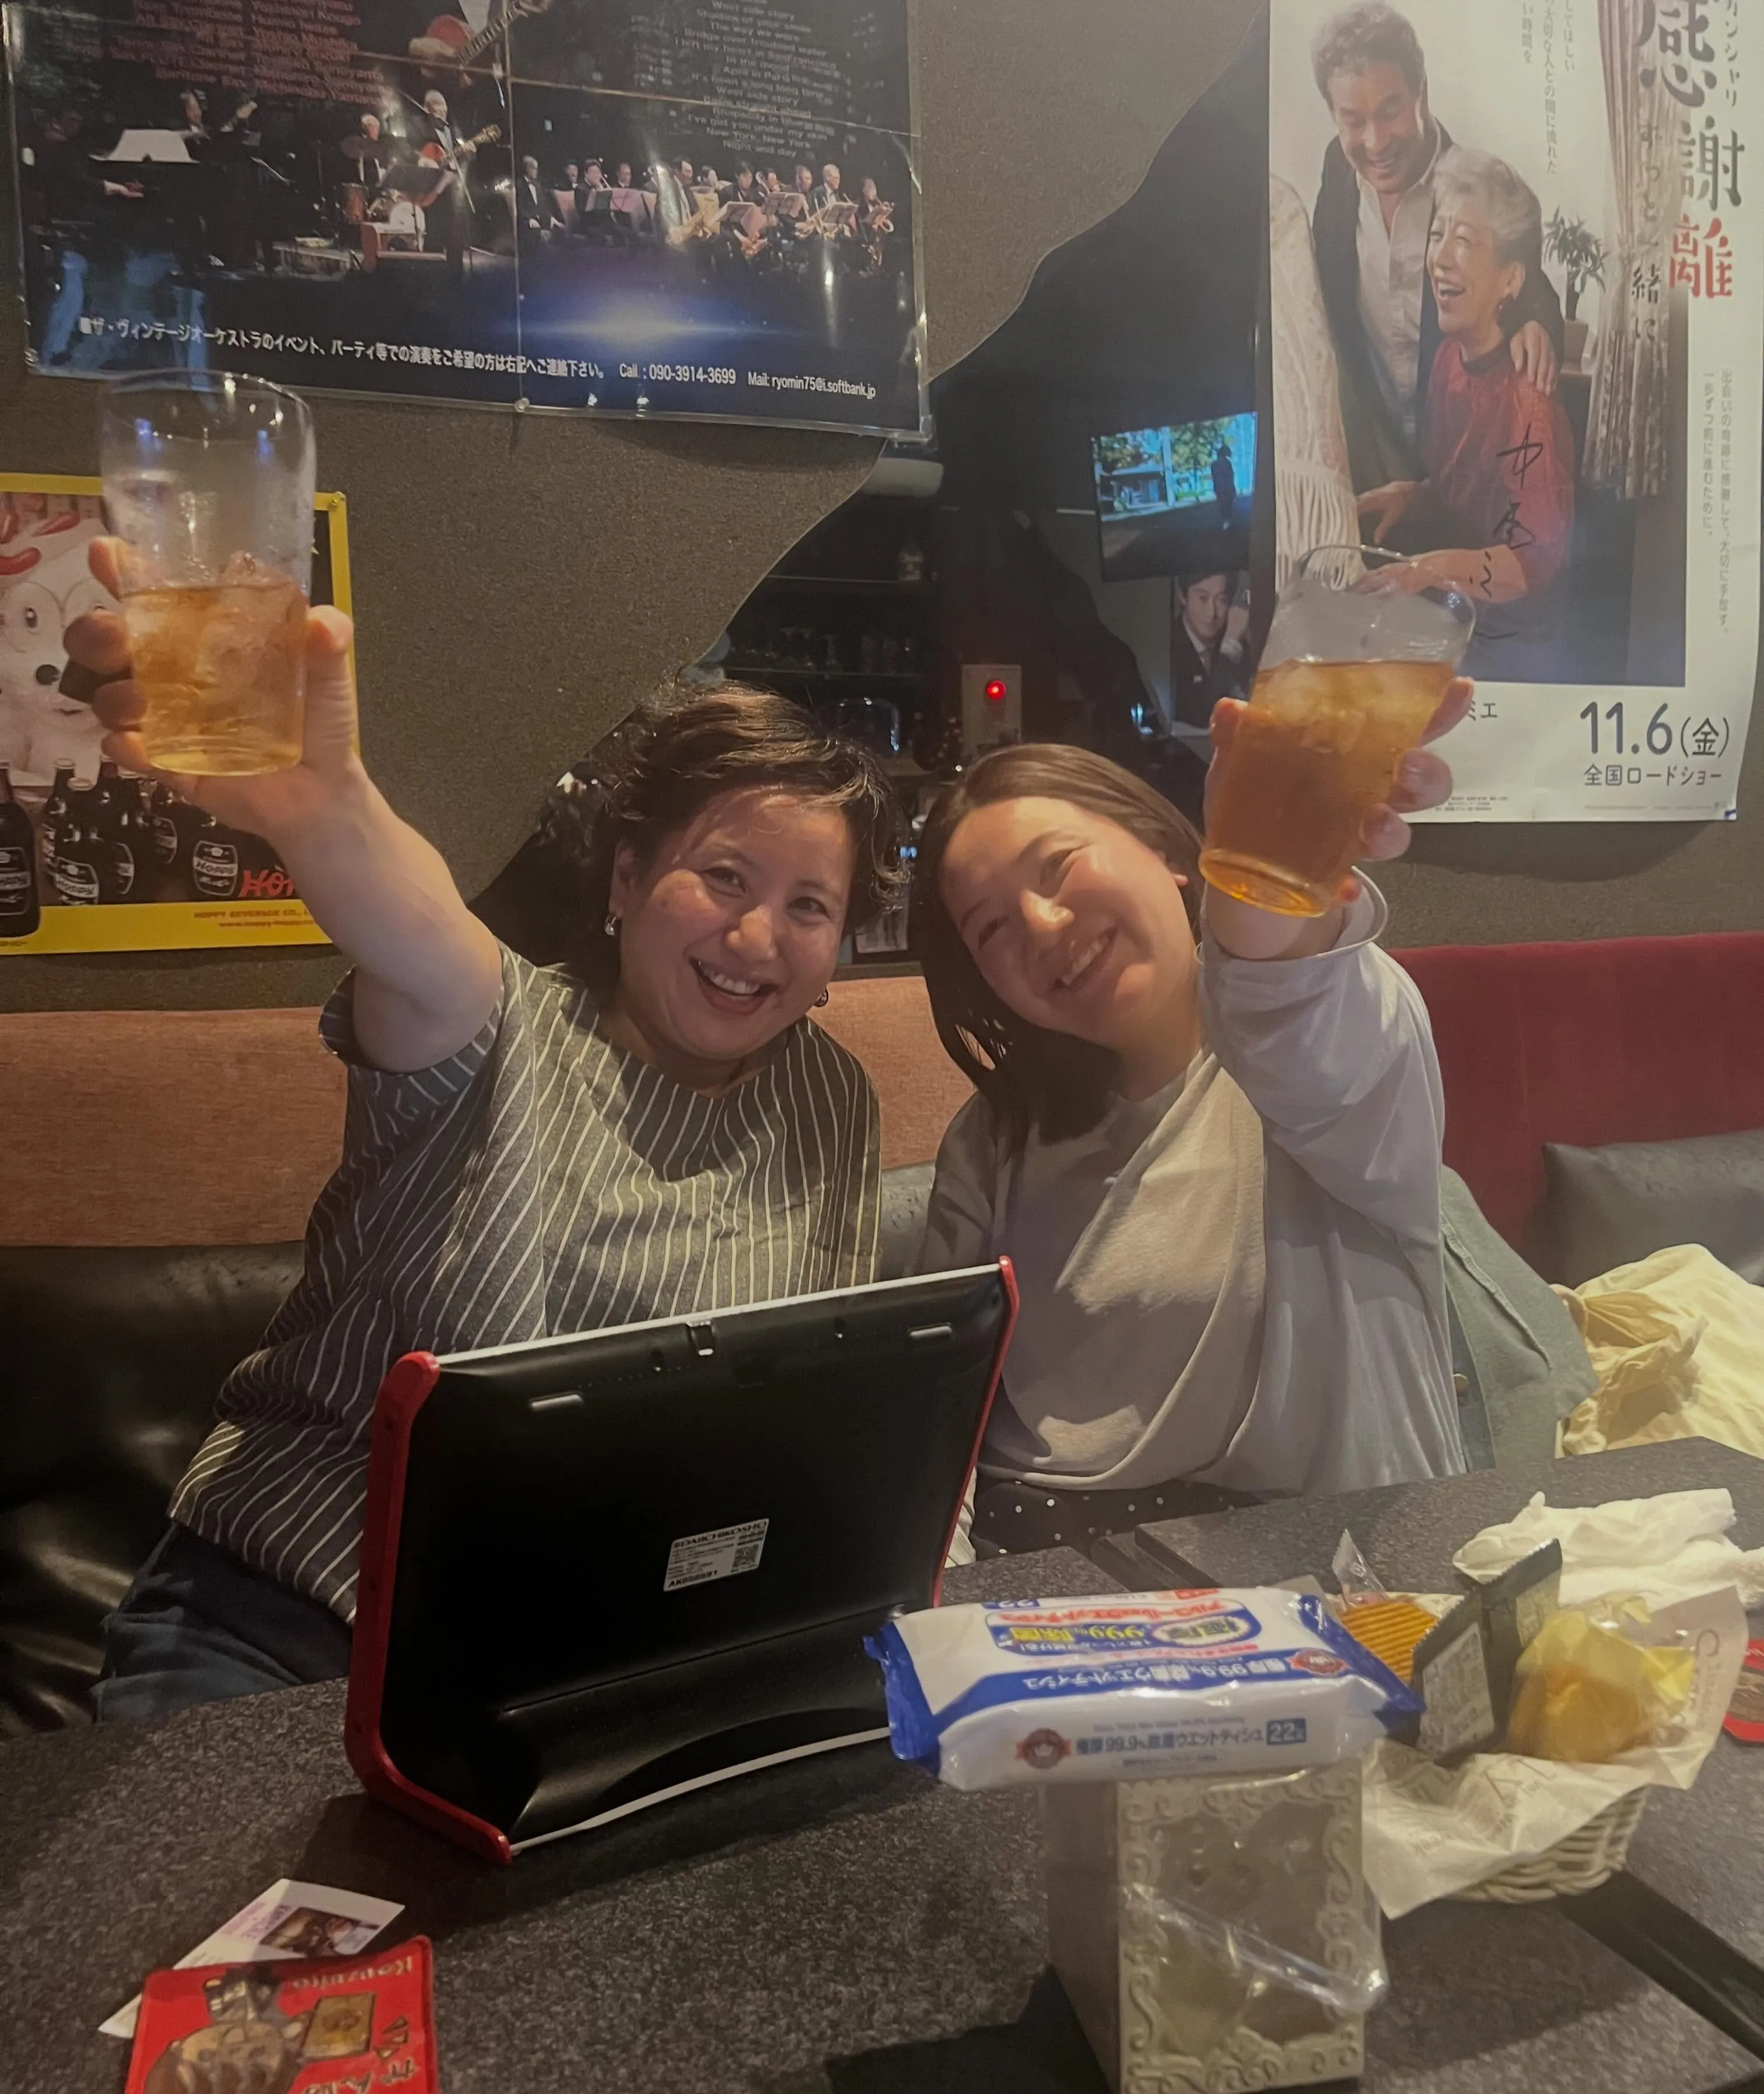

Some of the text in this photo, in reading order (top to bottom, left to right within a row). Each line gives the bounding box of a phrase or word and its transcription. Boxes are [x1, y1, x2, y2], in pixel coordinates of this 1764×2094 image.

[649, 365, 736, 384] 090-3914-3699
[1583, 763, 1722, 787] 全国ロードショー
